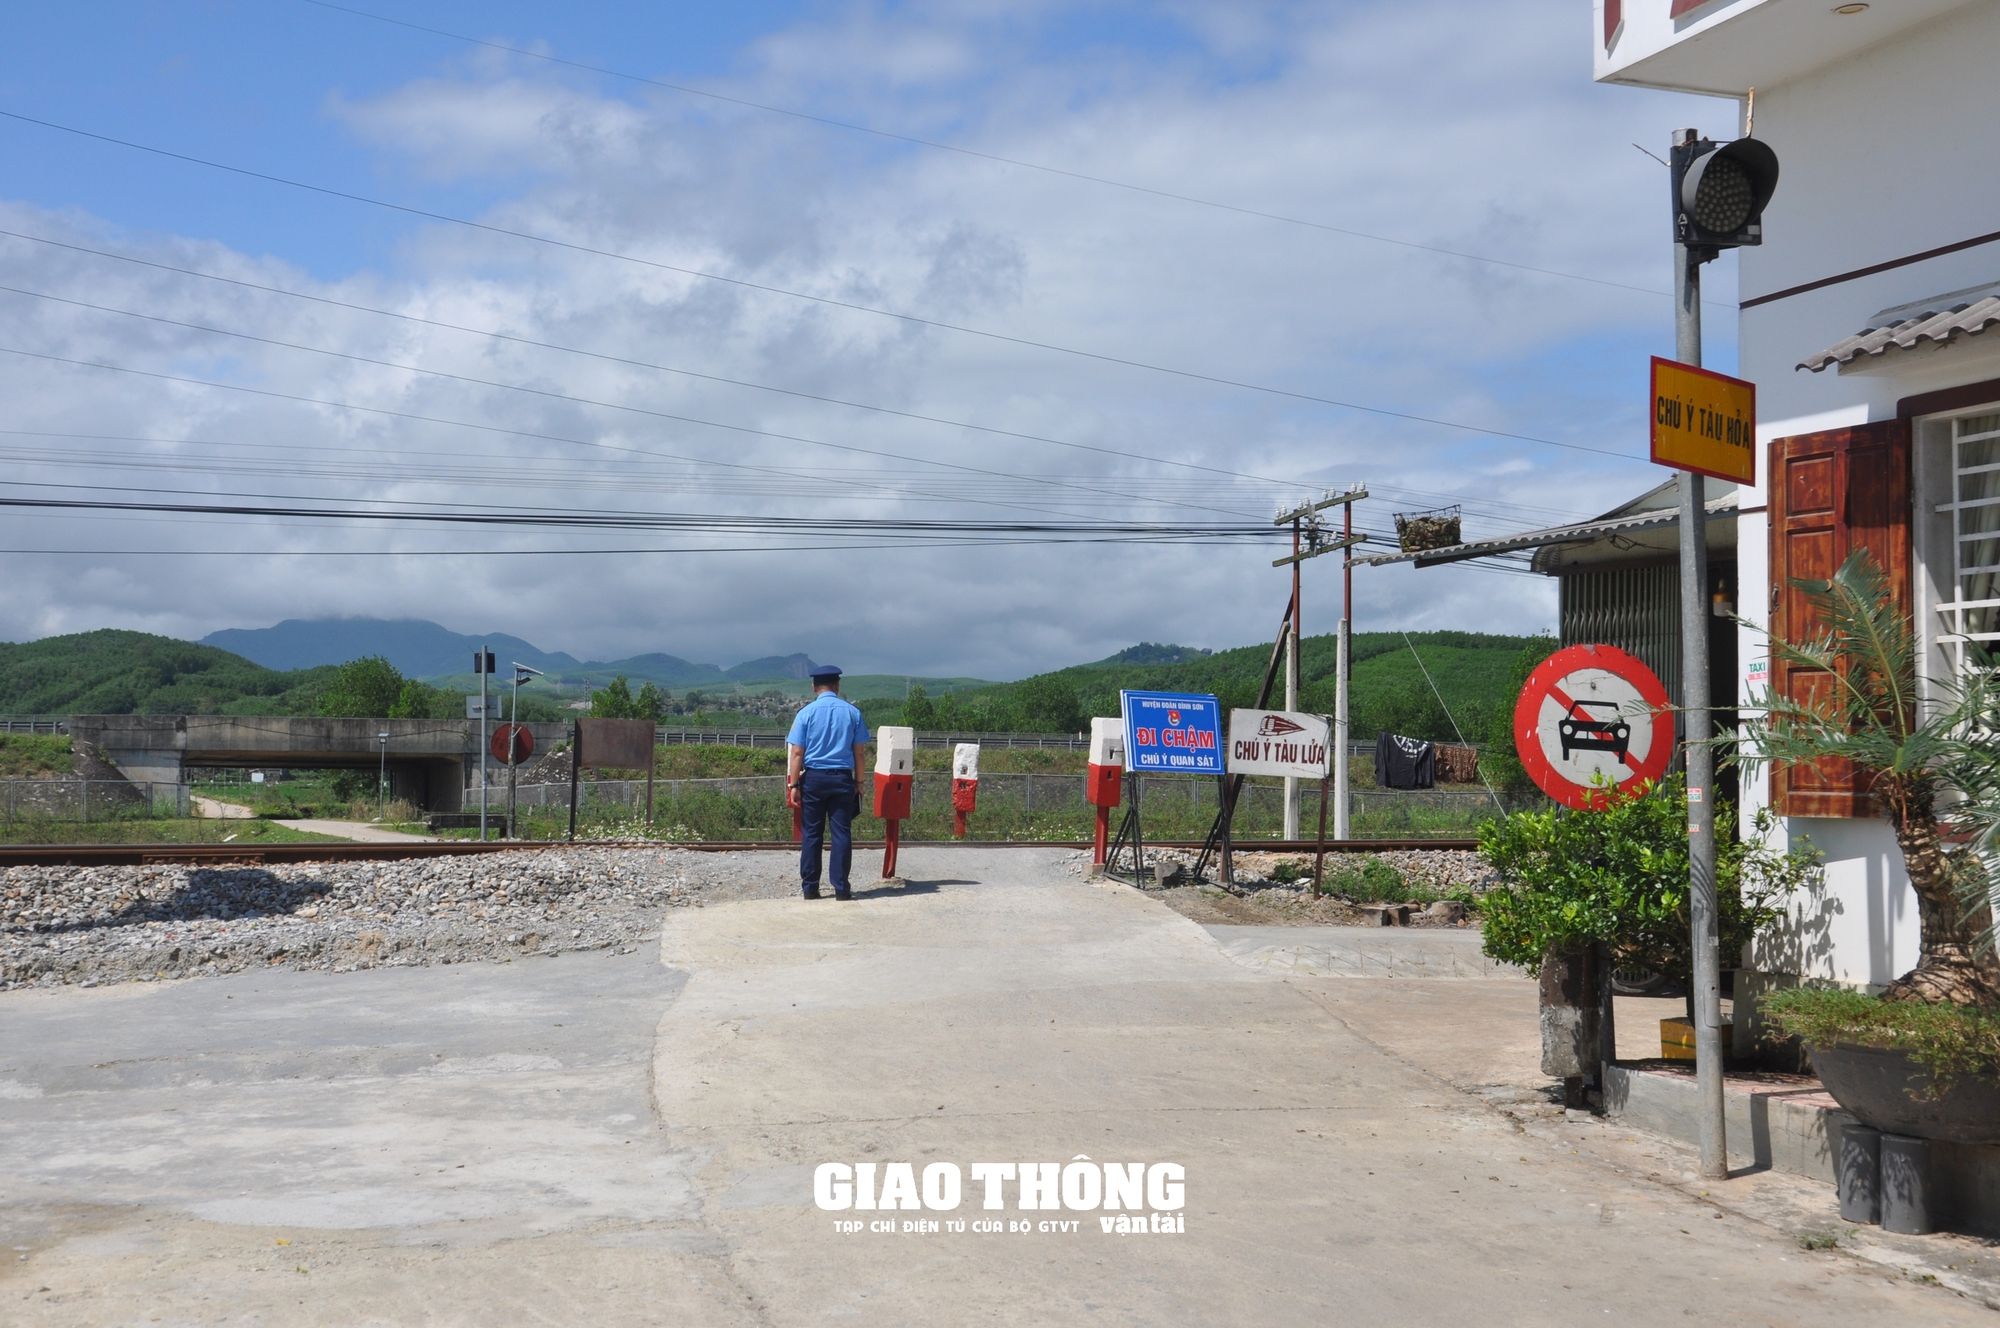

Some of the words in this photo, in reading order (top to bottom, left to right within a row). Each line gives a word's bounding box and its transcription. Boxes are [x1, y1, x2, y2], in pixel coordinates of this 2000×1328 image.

[1657, 394, 1681, 429] CHÚ
[1687, 398, 1694, 432] Ý
[1699, 404, 1723, 440] TÀU
[1726, 408, 1750, 449] HỎA
[1749, 662, 1766, 673] TAXI
[1136, 727, 1157, 746] ĐI
[1162, 725, 1215, 753] CHẬM
[1235, 738, 1259, 761] CHÚ
[1264, 738, 1271, 761] Ý
[1275, 739, 1298, 763] TÀU
[1301, 739, 1325, 764] LỬA
[1141, 753, 1160, 765] CHÚ
[1162, 753, 1167, 765] Ý
[1170, 755, 1195, 766] QUAN
[1197, 755, 1214, 767] SÁT
